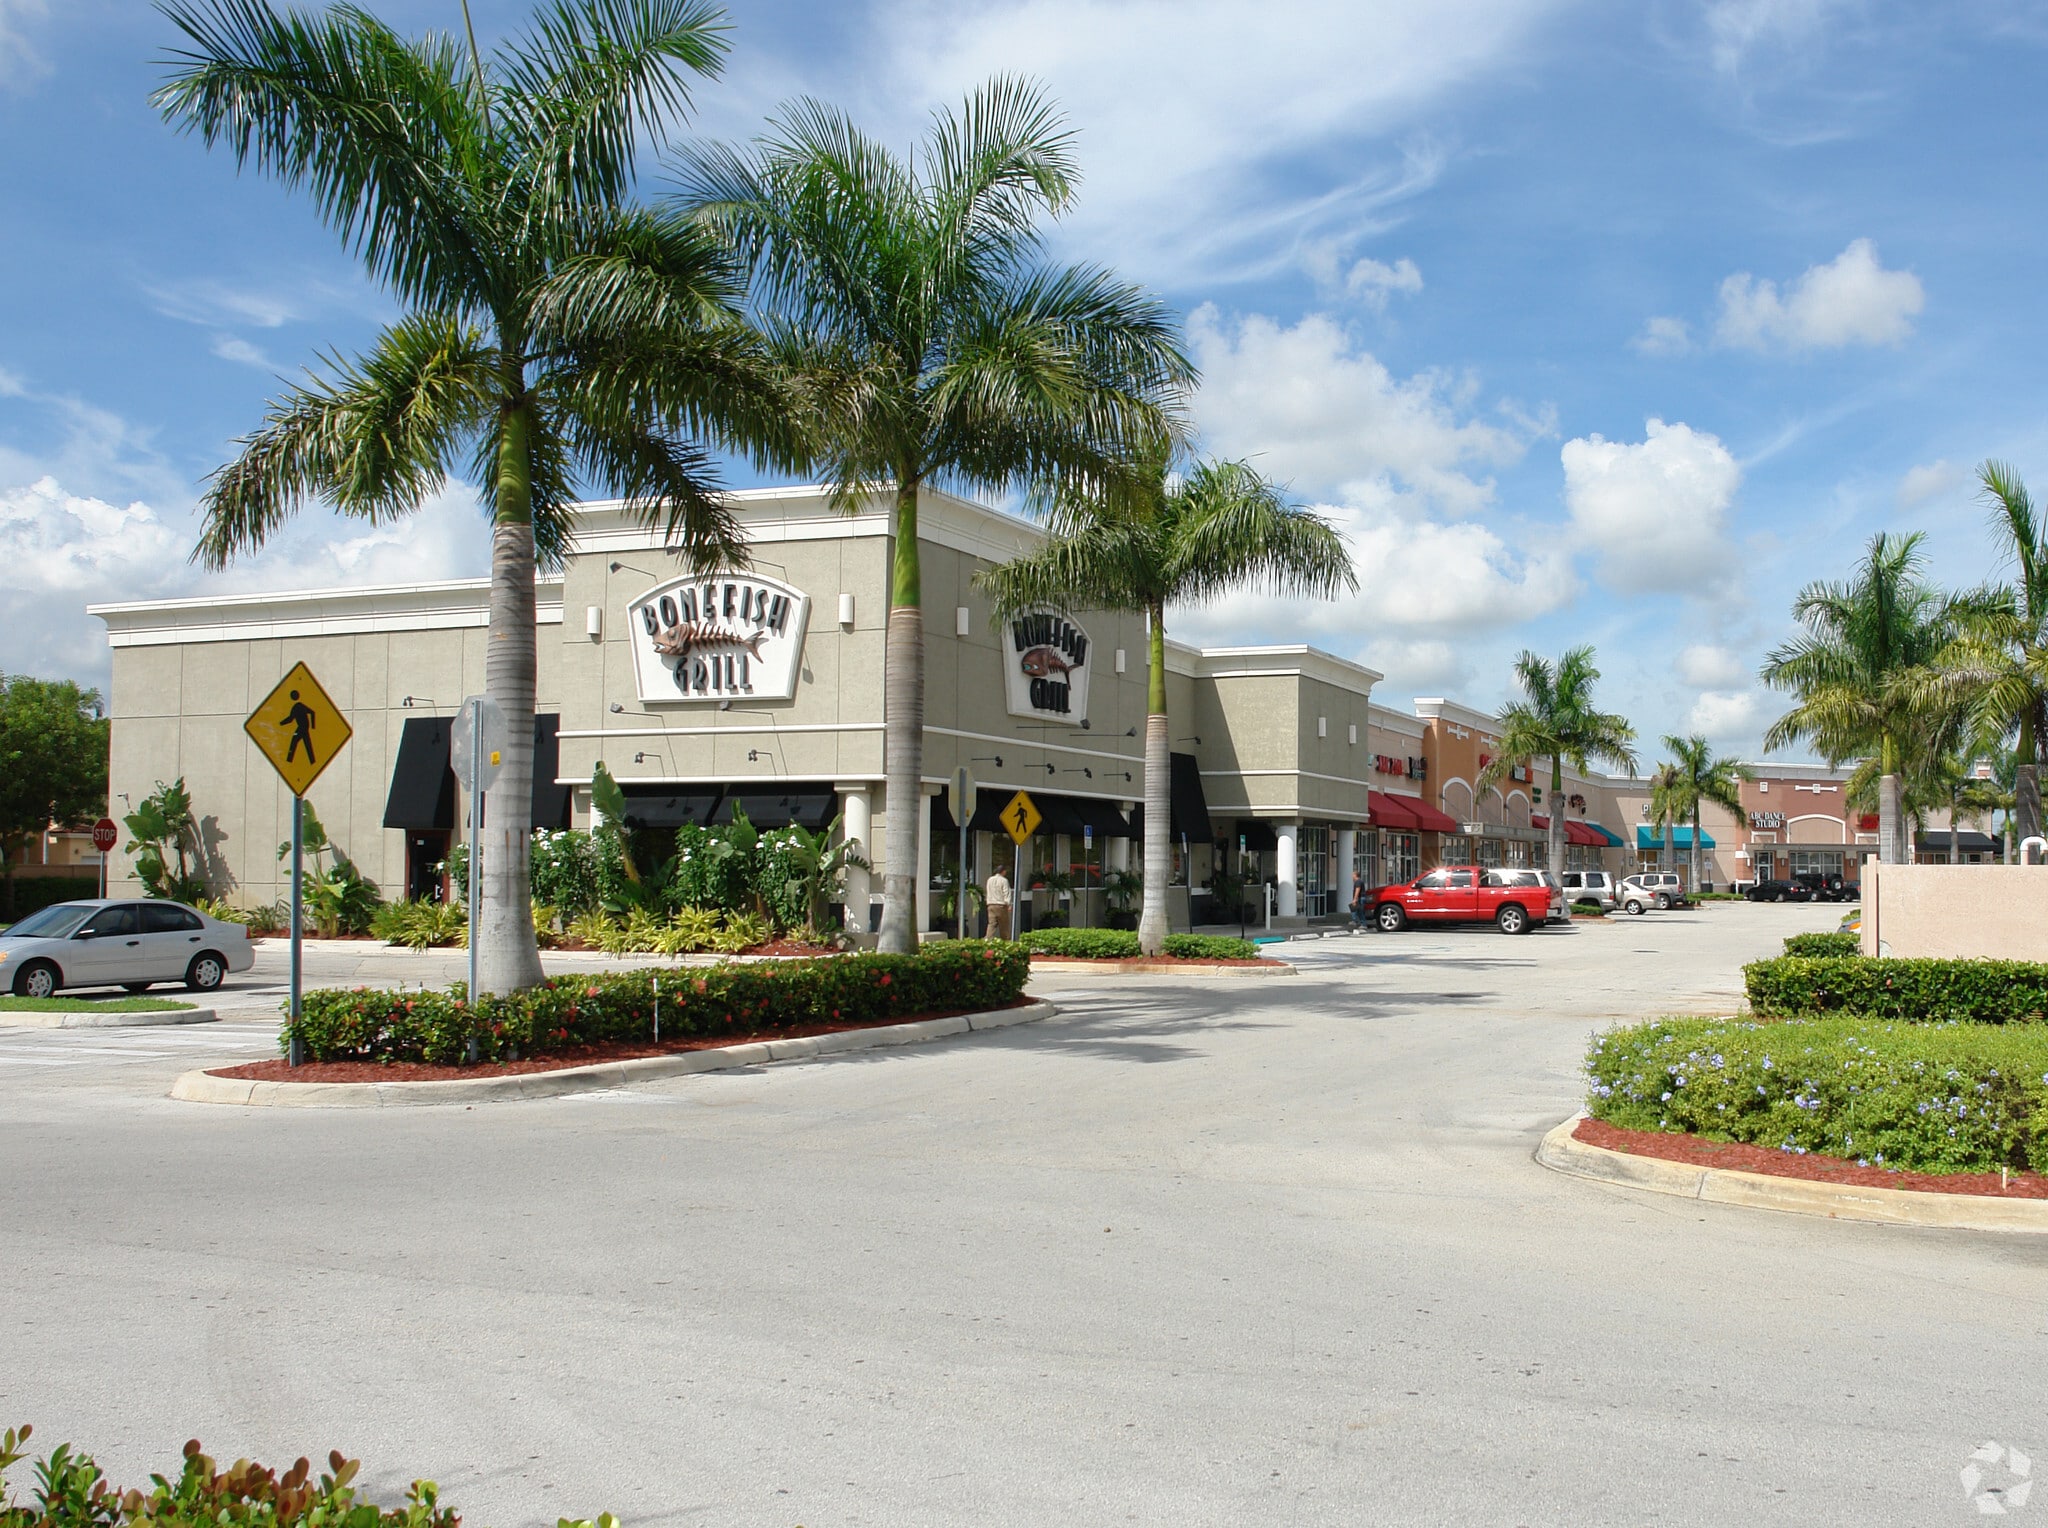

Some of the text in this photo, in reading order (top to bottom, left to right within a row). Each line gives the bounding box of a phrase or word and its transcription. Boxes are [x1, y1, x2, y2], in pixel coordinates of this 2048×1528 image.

[641, 584, 790, 636] BONEFISH
[673, 656, 753, 692] GRILL
[1764, 811, 1786, 820] DANCE
[1755, 820, 1780, 828] STUDIO
[94, 829, 116, 841] STOP
